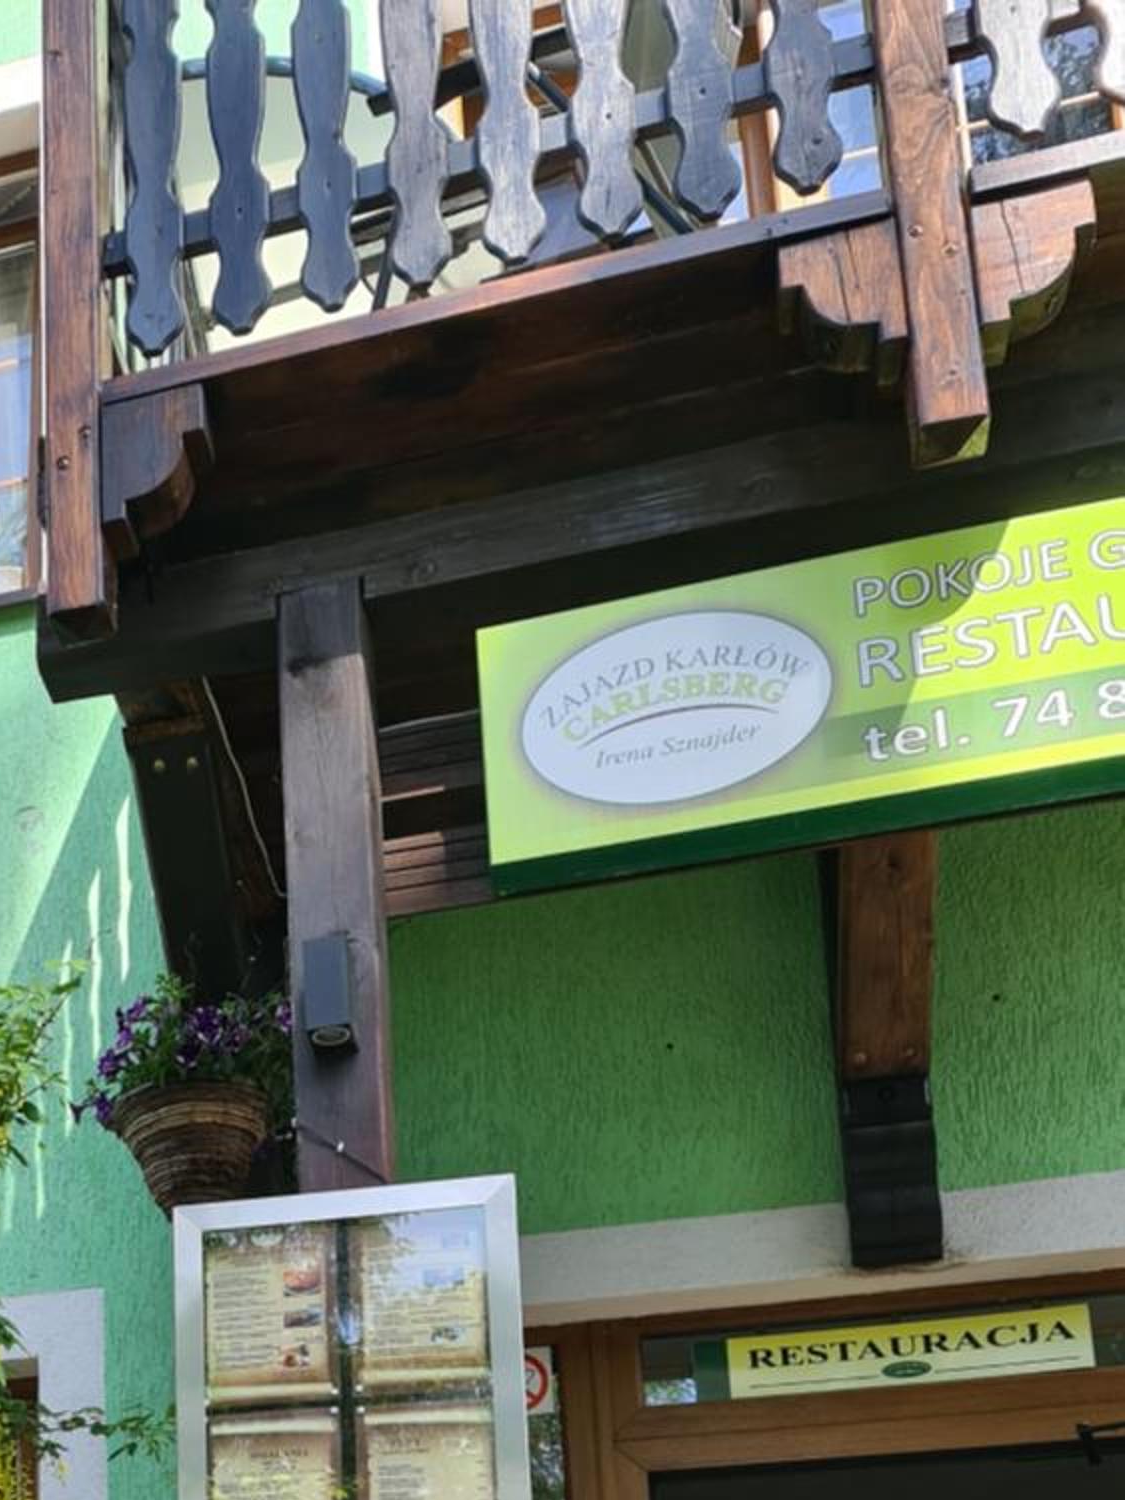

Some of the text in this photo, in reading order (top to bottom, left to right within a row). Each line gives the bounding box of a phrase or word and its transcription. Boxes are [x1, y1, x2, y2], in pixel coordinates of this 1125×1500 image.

[853, 539, 1072, 618] POKOJE
[538, 643, 811, 729] ZAJAZD KARŁÓW
[561, 671, 790, 742] CARLSBERG
[594, 722, 763, 769] Irena Sznajder
[863, 706, 971, 762] tel.
[992, 688, 1074, 738] 74
[748, 1320, 1075, 1369] RESTAURACJA
